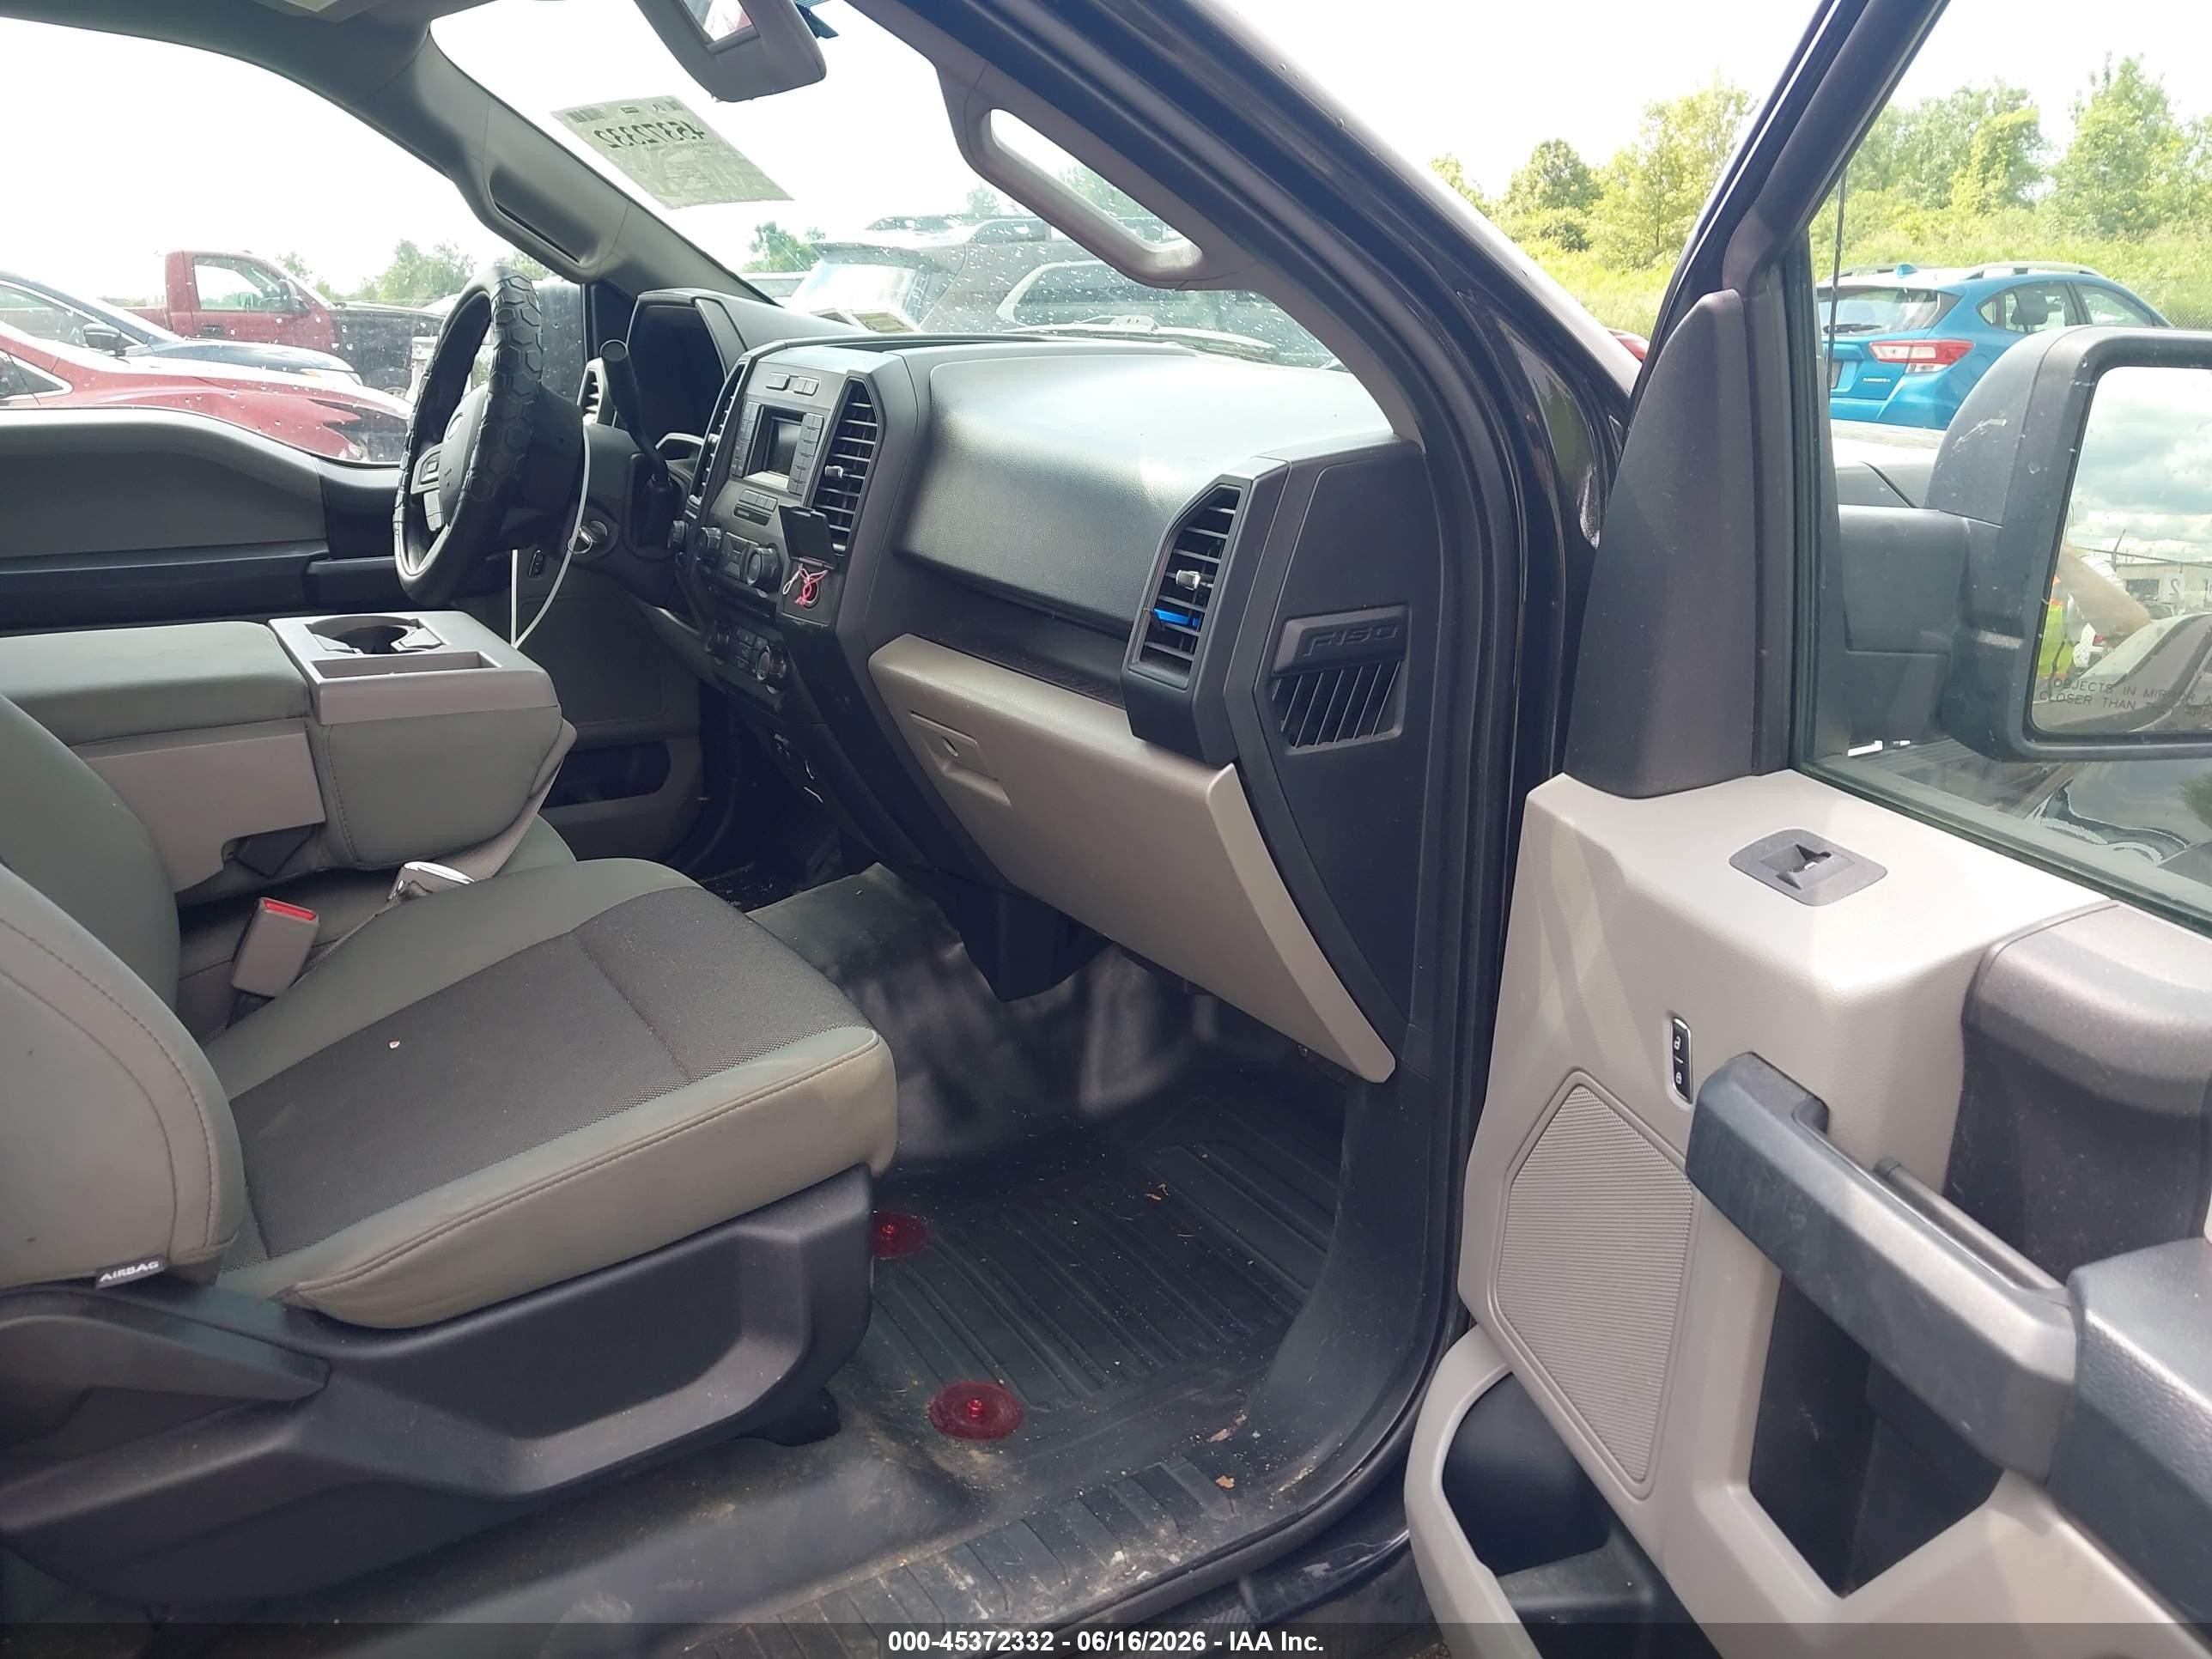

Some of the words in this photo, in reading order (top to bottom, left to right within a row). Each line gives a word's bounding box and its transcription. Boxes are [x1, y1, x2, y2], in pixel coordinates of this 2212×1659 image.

[2053, 678, 2114, 694] OBJECTS
[2123, 685, 2137, 696] IN
[2039, 690, 2094, 706] CLOSER
[2103, 696, 2136, 710] THAN
[99, 1260, 160, 1282] AIRBAG
